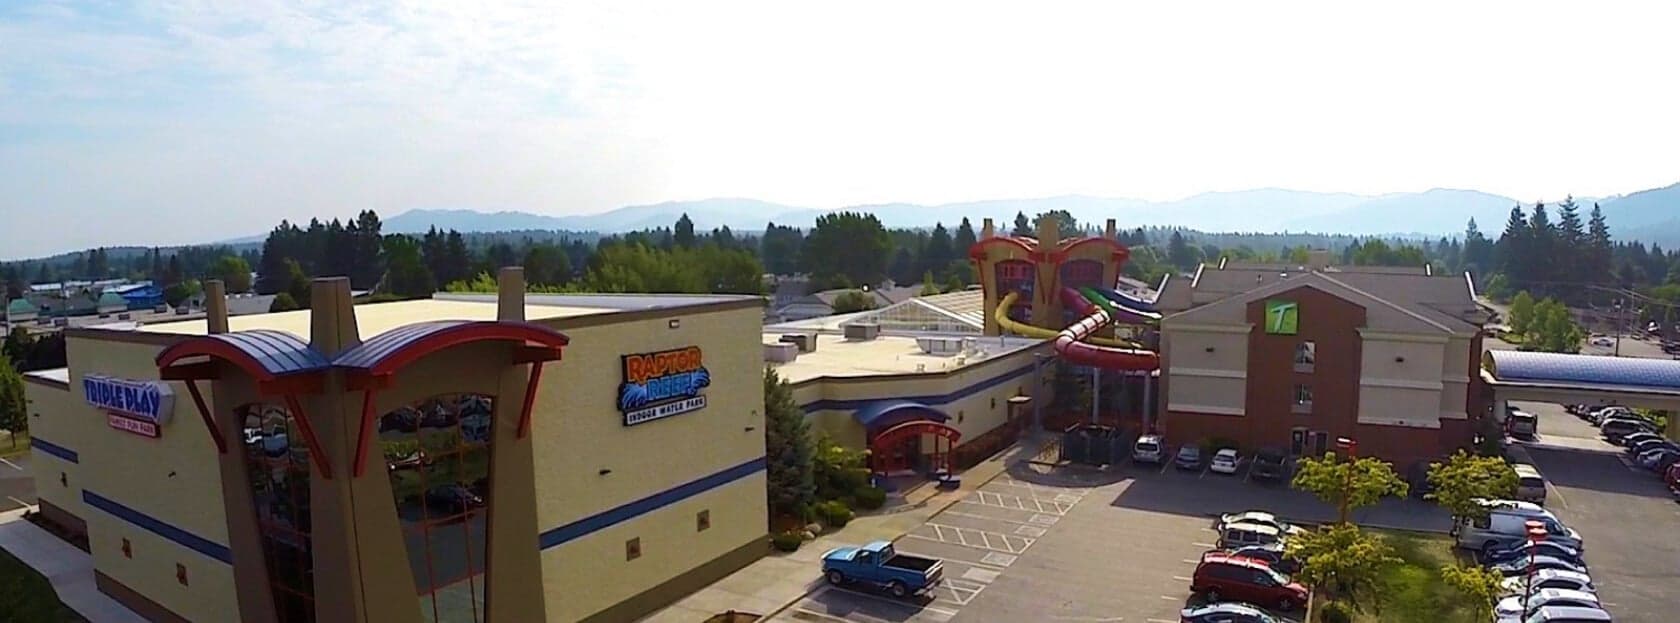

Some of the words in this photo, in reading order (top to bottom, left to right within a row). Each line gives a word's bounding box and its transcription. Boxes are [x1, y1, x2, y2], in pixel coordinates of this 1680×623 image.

[627, 348, 701, 384] RAPTOR
[84, 379, 125, 409] TRIPLE
[125, 385, 160, 418] PLAY
[647, 373, 692, 400] REEF
[629, 408, 657, 422] INDOOR
[660, 402, 683, 415] WATER
[686, 398, 703, 409] PARK
